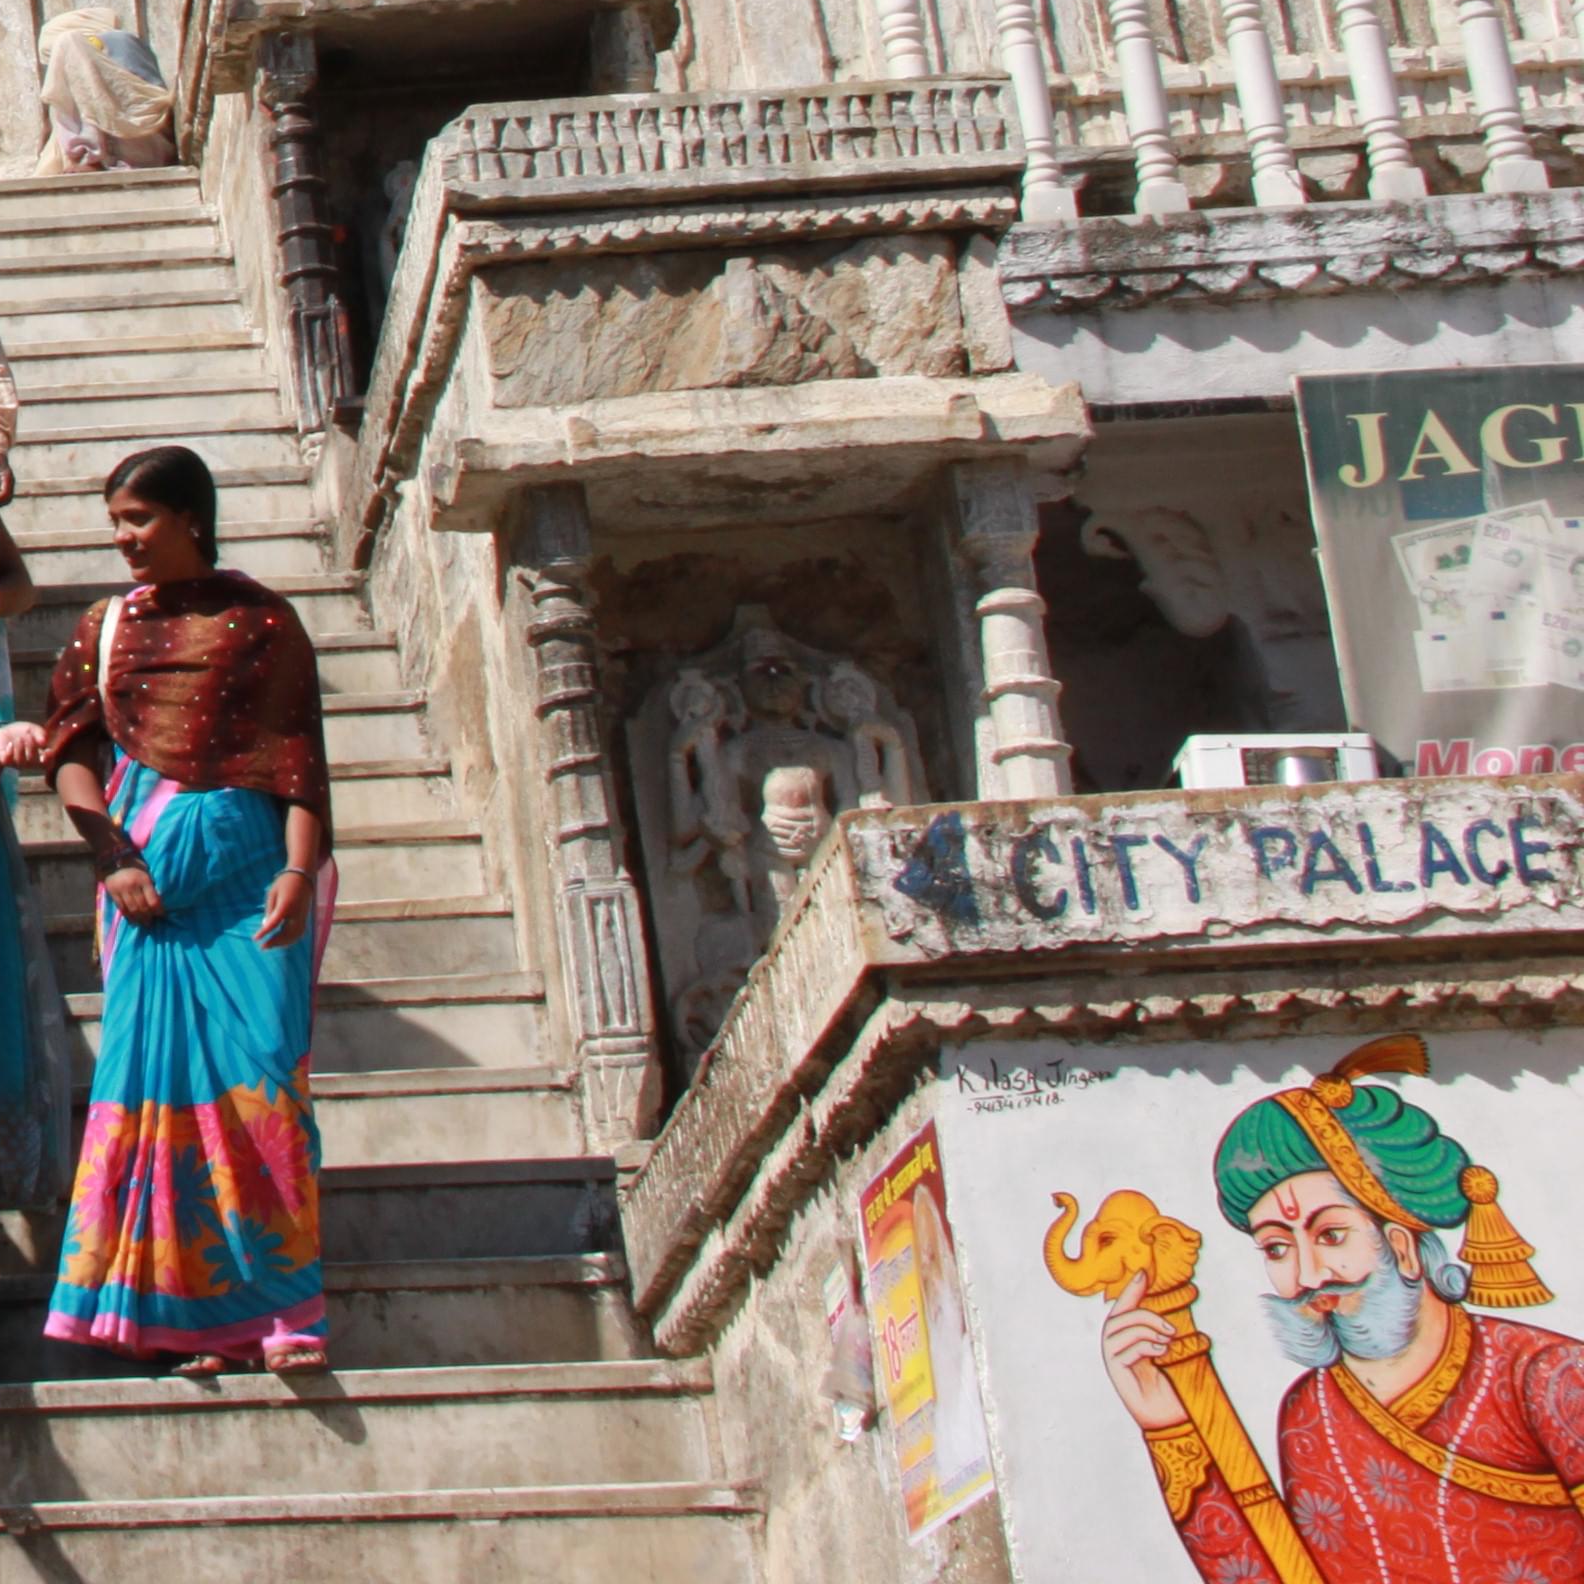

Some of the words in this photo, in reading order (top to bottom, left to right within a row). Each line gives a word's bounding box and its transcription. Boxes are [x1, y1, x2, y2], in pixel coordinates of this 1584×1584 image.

[1338, 402, 1584, 488] JAG
[1011, 820, 1208, 916] CITY
[1248, 816, 1556, 896] PALACE
